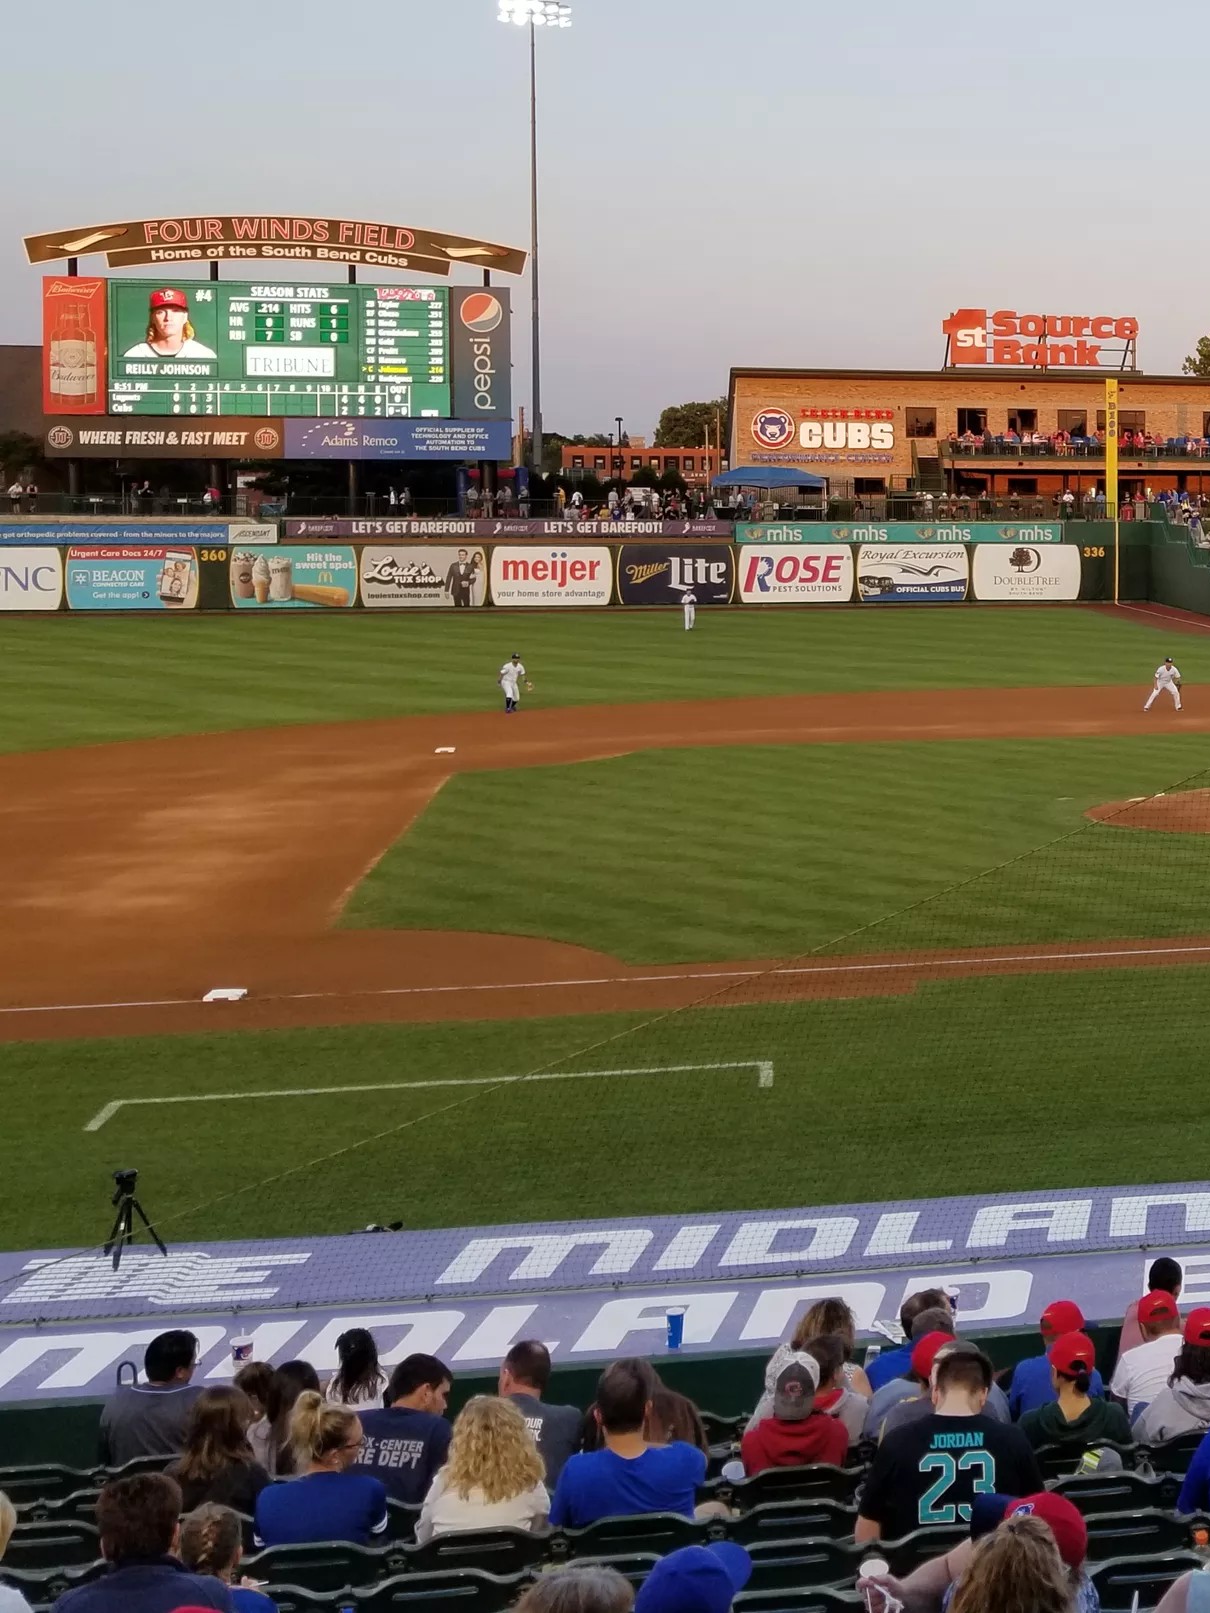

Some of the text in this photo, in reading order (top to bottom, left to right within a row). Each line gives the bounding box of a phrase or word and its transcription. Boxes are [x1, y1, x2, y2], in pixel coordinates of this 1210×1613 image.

[143, 218, 415, 250] FOUR WINDS FIELD
[151, 245, 408, 267] Home of the South Bend Cubs
[195, 289, 212, 302] #4
[250, 286, 330, 299] SEASON STATS
[229, 302, 312, 314] AVG .214 HITS
[229, 316, 337, 328] HR RUNS 1
[992, 310, 1139, 340] Source
[265, 331, 273, 341] 7
[289, 331, 303, 341] SB
[993, 339, 1101, 366] Bank
[125, 363, 210, 376] REILLY JOHNSON
[250, 357, 331, 374] TRIBUNE
[469, 337, 496, 410] pepsi
[135, 383, 148, 391] PM
[273, 384, 280, 392] 7
[390, 386, 407, 394] OUT
[206, 394, 365, 404] 3 4 4
[112, 404, 381, 415] Cubs 2 2 3 2
[853, 408, 894, 420] BEND
[79, 431, 122, 445] WHERE
[124, 431, 165, 445] FRESH
[165, 430, 179, 445] &
[181, 431, 212, 446] FAST
[213, 432, 248, 446] MEET
[321, 435, 398, 447] Adams Remco
[800, 421, 894, 449] CUBS
[351, 521, 663, 534] LET'S GET BAREFOOT! LET'S GET BAREFOOT!
[766, 526, 803, 542] mhs
[852, 525, 888, 541] mhs
[937, 525, 972, 541] mhs
[1019, 525, 1053, 541] mhs
[57, 531, 89, 539] problems
[70, 550, 99, 558] Urgent
[200, 550, 227, 561] 360
[306, 553, 342, 561] Hit the
[860, 549, 964, 561] Royal Excursion
[1083, 547, 1105, 558] 336
[295, 561, 355, 570] sweet spot.
[363, 555, 430, 580] Louie's
[502, 552, 601, 588] meijer
[0, 566, 56, 591] NC
[92, 570, 145, 582] BEACON
[626, 557, 727, 591] Miller Lite
[743, 555, 845, 593] ROSE
[92, 591, 139, 600] Get the app!
[497, 590, 515, 599] your
[565, 590, 606, 599] advantage
[772, 585, 843, 593] PEST SOLUTIONS
[951, 585, 966, 593] BUS
[368, 592, 440, 600] louiestuxshop.com
[930, 1432, 984, 1449] JORDAN
[378, 1450, 421, 1469] DEPT
[918, 1450, 996, 1524] 23
